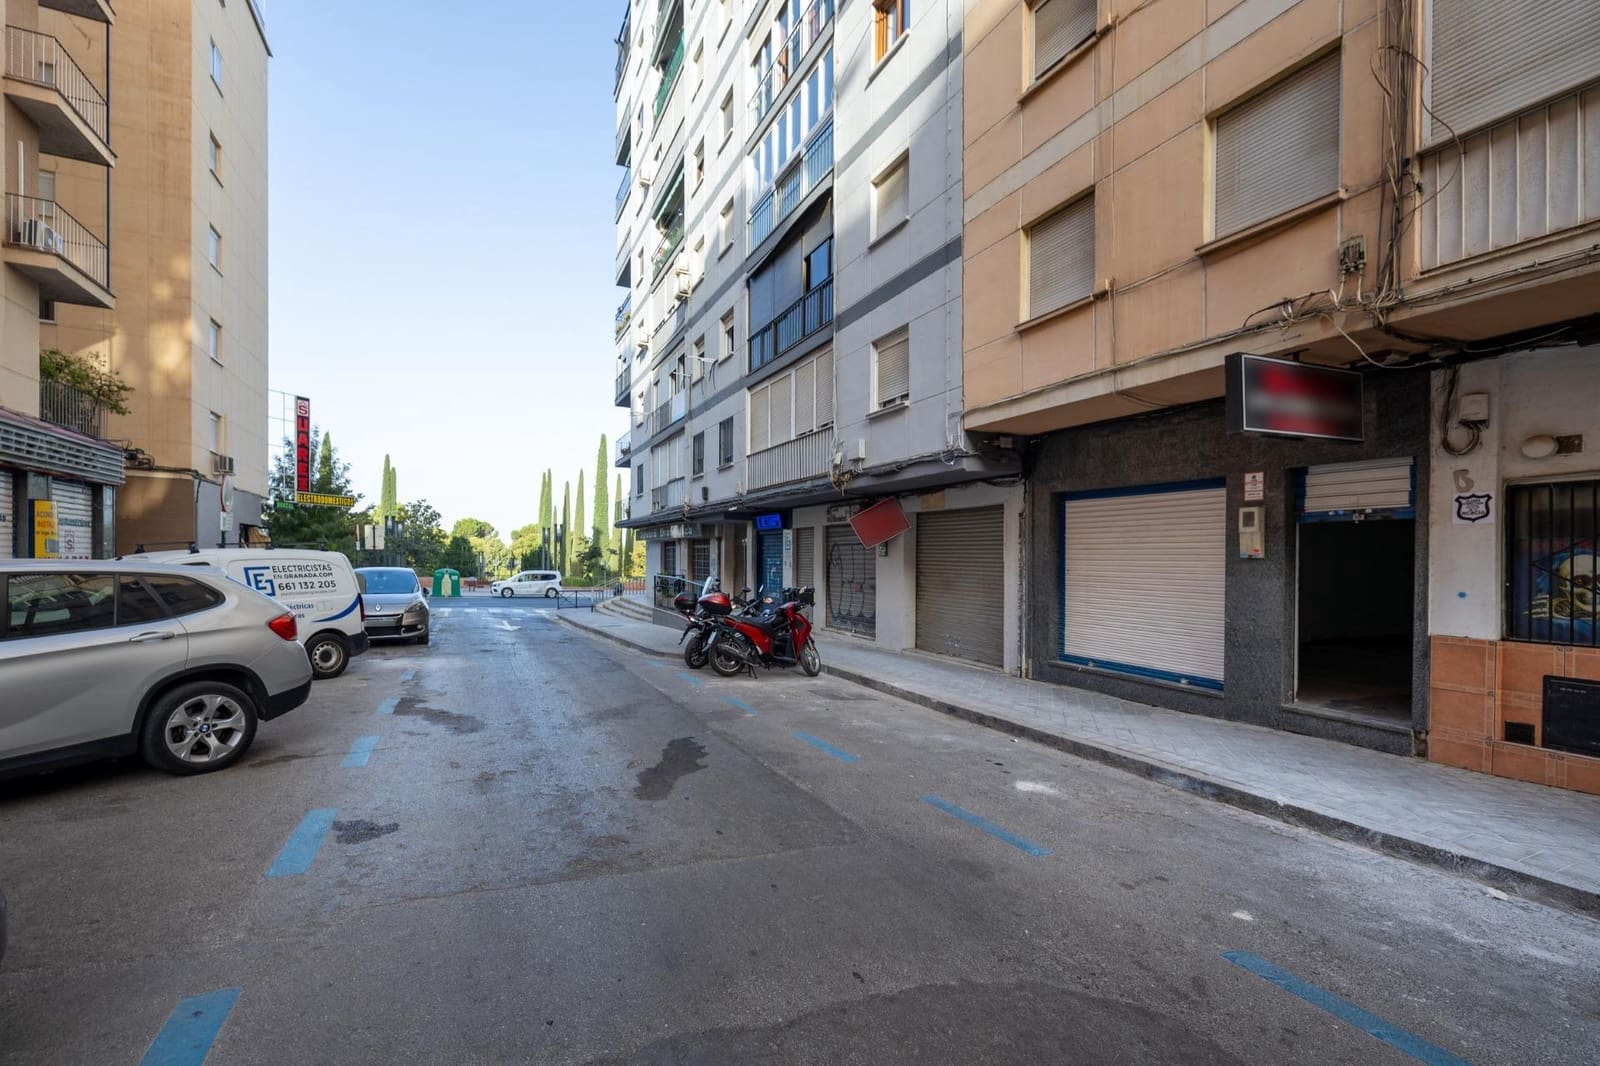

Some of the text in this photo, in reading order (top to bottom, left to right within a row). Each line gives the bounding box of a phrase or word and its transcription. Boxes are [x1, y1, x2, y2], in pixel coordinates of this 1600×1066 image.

[272, 564, 332, 573] ELECTRICISTAS
[278, 580, 337, 591] 661 132 205
